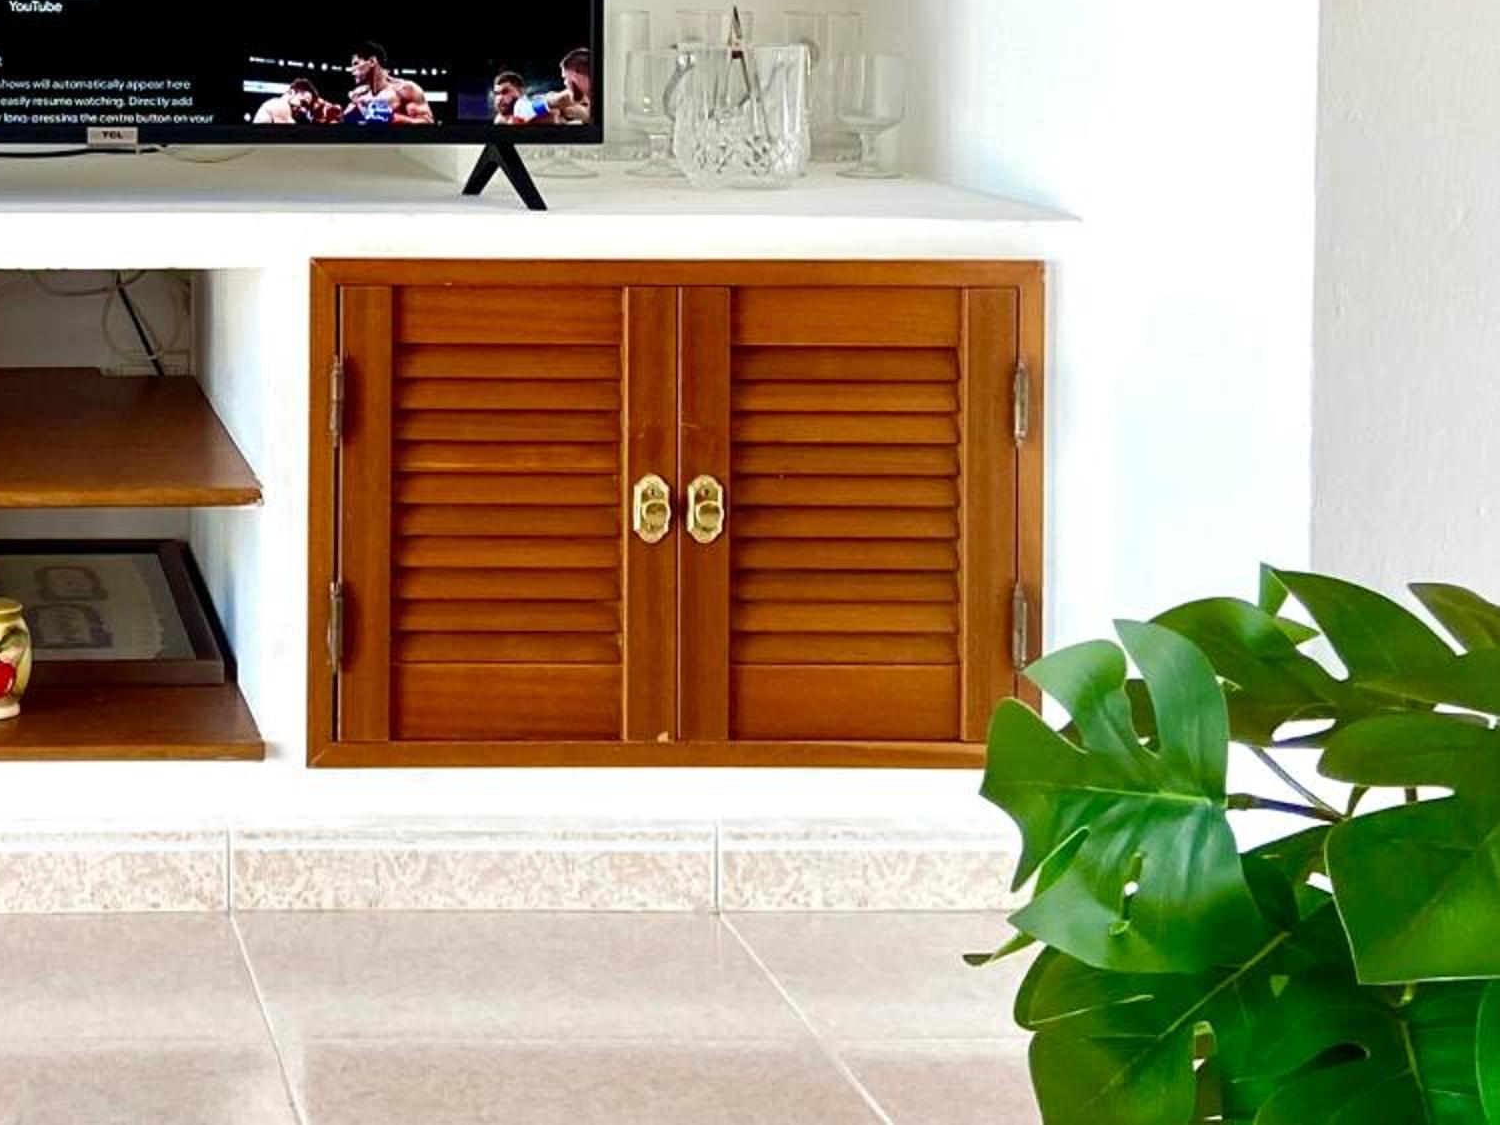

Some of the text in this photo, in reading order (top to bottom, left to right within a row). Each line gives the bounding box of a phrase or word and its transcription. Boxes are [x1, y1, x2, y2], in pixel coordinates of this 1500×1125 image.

[9, 0, 63, 13] YouTube
[32, 79, 51, 90] will
[52, 79, 124, 91] automatically
[126, 81, 165, 92] appear
[167, 80, 191, 90] here
[0, 96, 30, 108] easily
[32, 97, 73, 107] resume
[129, 97, 170, 108] Directly
[171, 97, 193, 107] add
[80, 113, 97, 123] the
[100, 113, 134, 123] centre
[136, 113, 172, 123] button
[173, 114, 188, 123] on
[189, 114, 214, 123] your
[101, 130, 123, 140] TCL
